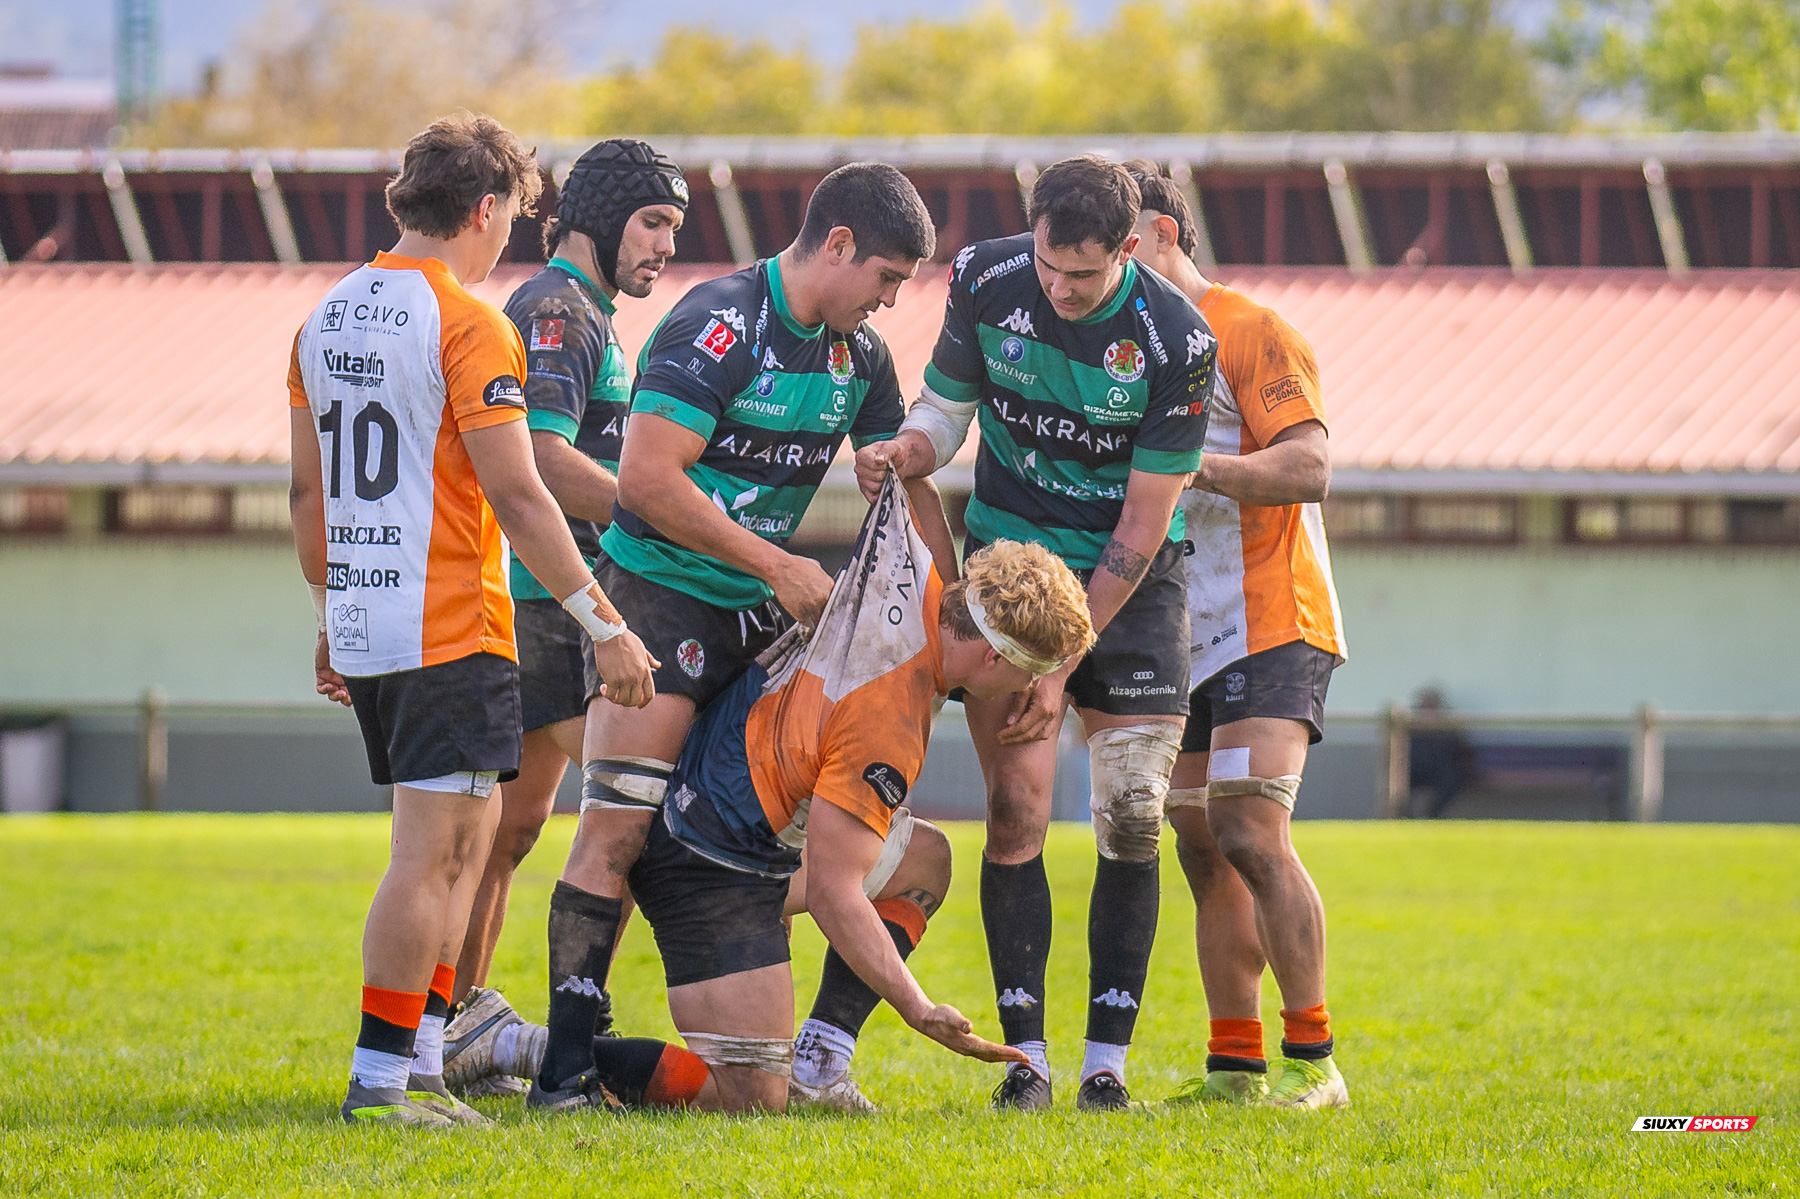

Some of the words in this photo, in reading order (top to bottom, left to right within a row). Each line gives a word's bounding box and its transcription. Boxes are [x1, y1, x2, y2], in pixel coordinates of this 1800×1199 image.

[977, 252, 1030, 287] ASIMAIR
[354, 304, 409, 326] CAVO
[1138, 310, 1169, 365] ASIMAIR
[323, 348, 384, 376] Vitaldin
[1264, 379, 1293, 398] GRUPO
[734, 398, 788, 417] RONIMET
[1083, 404, 1144, 418] BIZKAIMETAL
[319, 399, 399, 501] 10
[328, 525, 402, 545] IRCLE
[1108, 686, 1142, 698] Alzaga
[1143, 684, 1177, 695] Gernika
